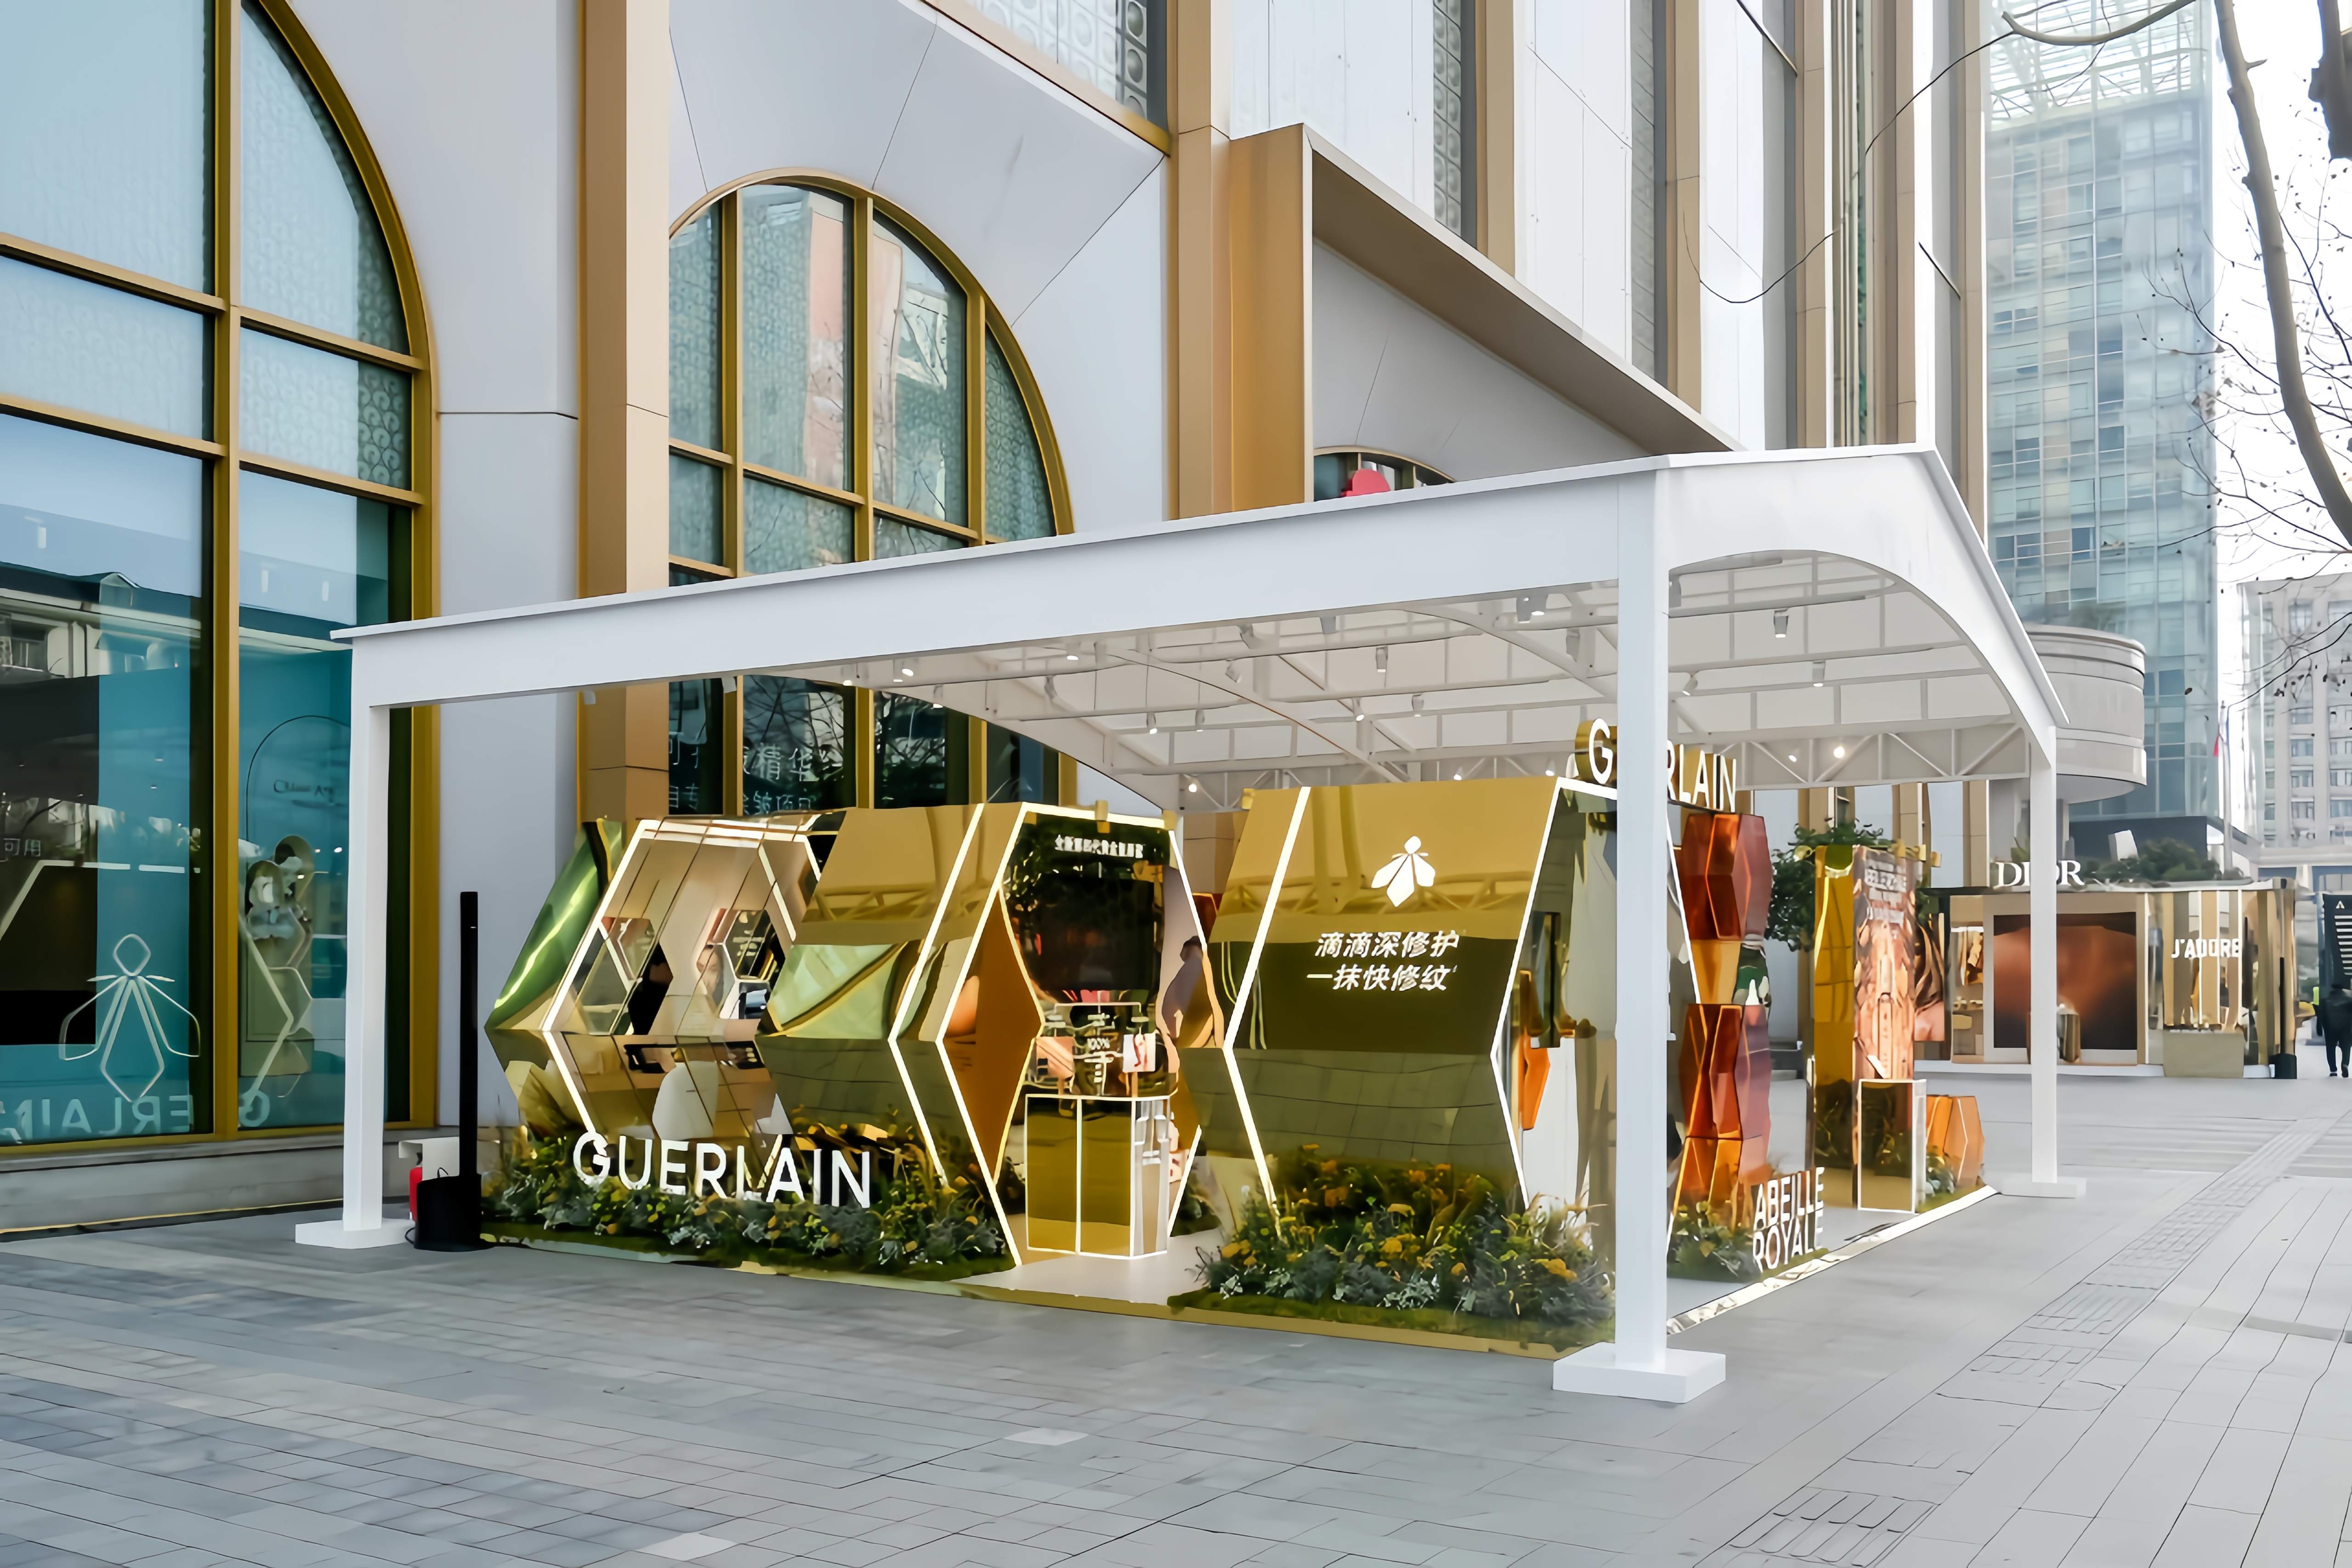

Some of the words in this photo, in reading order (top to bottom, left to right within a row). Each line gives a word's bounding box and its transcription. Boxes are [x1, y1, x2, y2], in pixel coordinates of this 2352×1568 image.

[1589, 717, 1737, 812] GRLAIN
[1993, 860, 2085, 889] DIR
[1315, 930, 1460, 957] 滴滴深修护
[2171, 938, 2239, 958] J'ADORE
[1307, 964, 1451, 991] 一抹快修纹
[574, 1131, 870, 1208] GUERLAIN
[1753, 1167, 1825, 1232] ABEILLE
[1753, 1209, 1824, 1273] ROYALE
